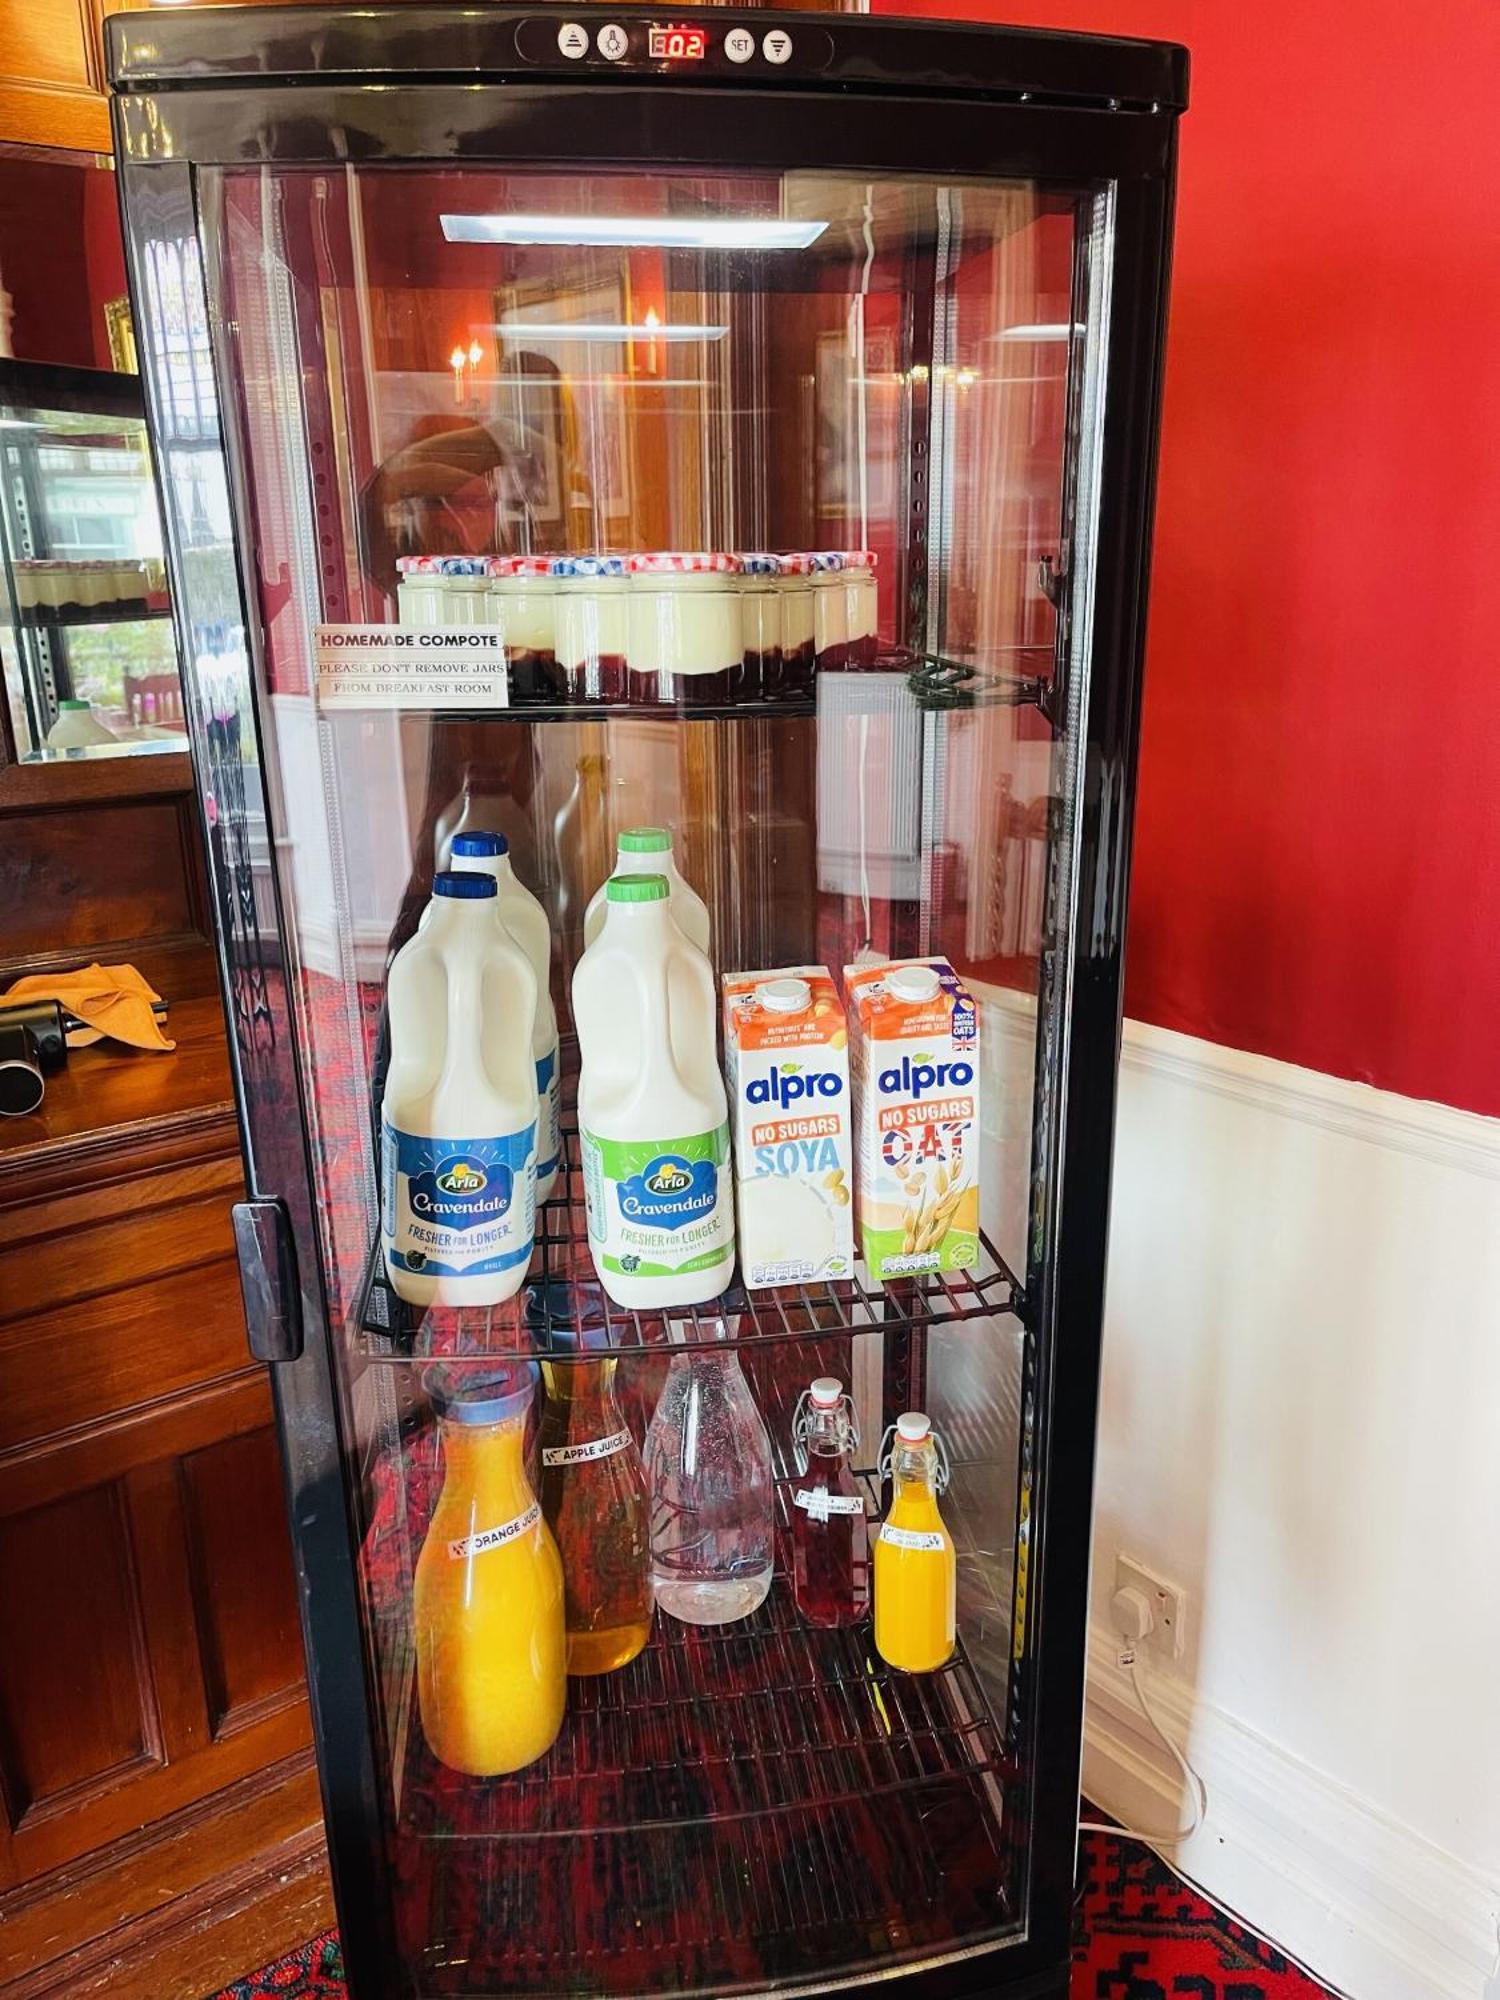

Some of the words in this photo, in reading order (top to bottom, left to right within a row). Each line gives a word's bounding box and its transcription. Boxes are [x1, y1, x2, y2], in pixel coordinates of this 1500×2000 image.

[731, 39, 748, 52] SET
[321, 635, 415, 647] HOMEMADE
[419, 635, 498, 646] COMPOTE
[319, 664, 369, 673] PLEASE
[372, 664, 410, 673] DON'T
[415, 664, 469, 673] REMOVE
[472, 664, 504, 674] JARS
[334, 683, 371, 693] FROM
[376, 684, 450, 693] BREAKFAST
[454, 684, 492, 693] ROOM
[953, 1027, 974, 1036] OATS
[746, 1066, 843, 1109] alpro
[878, 1056, 974, 1099] alpro
[882, 1110, 904, 1128] NO
[907, 1100, 971, 1123] SUGARS
[755, 1127, 776, 1143] NO
[778, 1118, 837, 1138] SUGARS
[882, 1122, 972, 1166] OAT
[755, 1137, 840, 1175] SOYA
[445, 1176, 478, 1189] Arla
[653, 1178, 685, 1190] Arla
[413, 1193, 507, 1214] Cravendale
[623, 1194, 714, 1216] Cravendale
[407, 1223, 451, 1246] FRESHER
[453, 1236, 468, 1245] FOR
[470, 1225, 512, 1245] LONGER
[620, 1228, 665, 1247] FRESHER
[666, 1236, 680, 1245] FOR
[682, 1220, 721, 1243] LONGER
[564, 1446, 596, 1460] APPLE
[600, 1436, 625, 1453] JUICE
[475, 1524, 521, 1548] ORANGE
